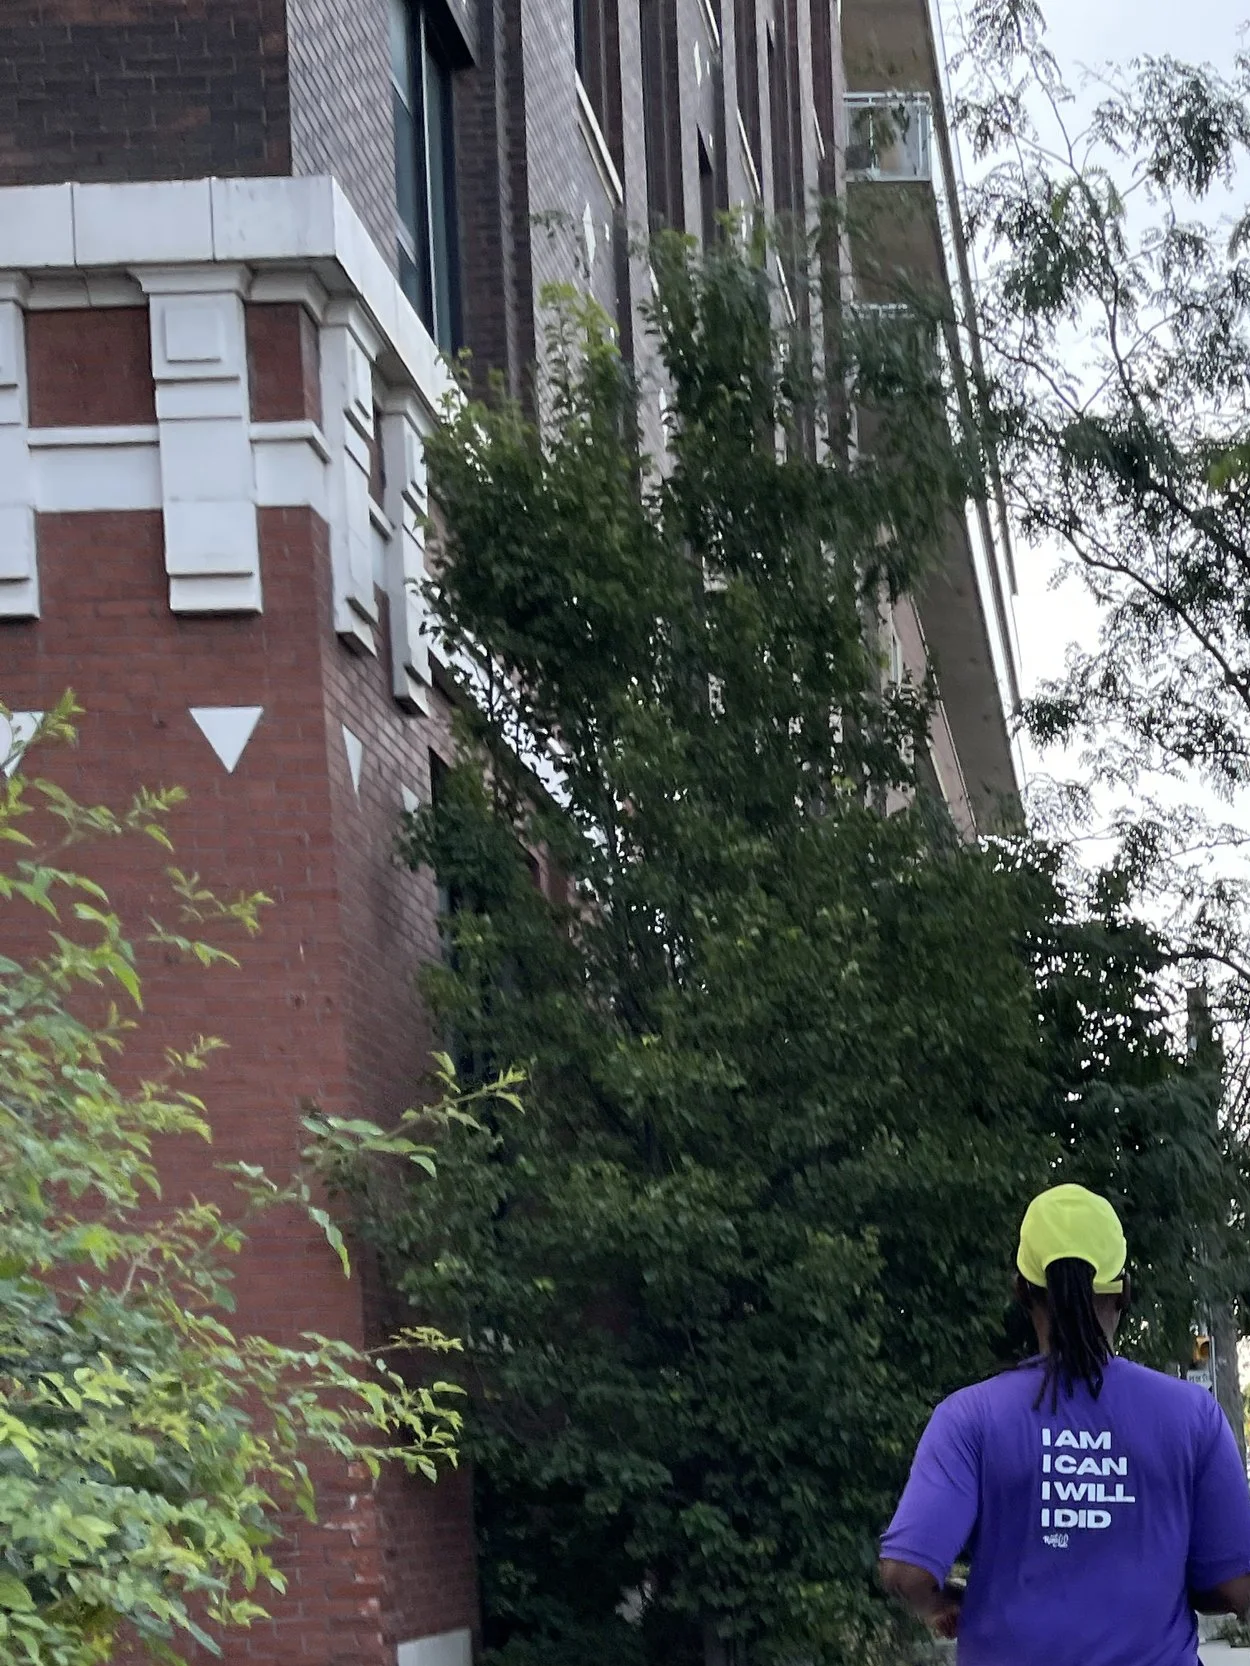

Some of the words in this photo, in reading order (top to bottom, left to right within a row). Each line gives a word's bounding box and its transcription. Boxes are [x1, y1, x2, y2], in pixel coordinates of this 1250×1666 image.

[1042, 1428, 1051, 1446] I
[1054, 1429, 1112, 1450] AM
[1042, 1454, 1051, 1473] I
[1054, 1454, 1128, 1476] CAN
[1041, 1481, 1051, 1500] I
[1053, 1481, 1136, 1503] WILL
[1041, 1508, 1050, 1527] I
[1054, 1508, 1112, 1529] DID
